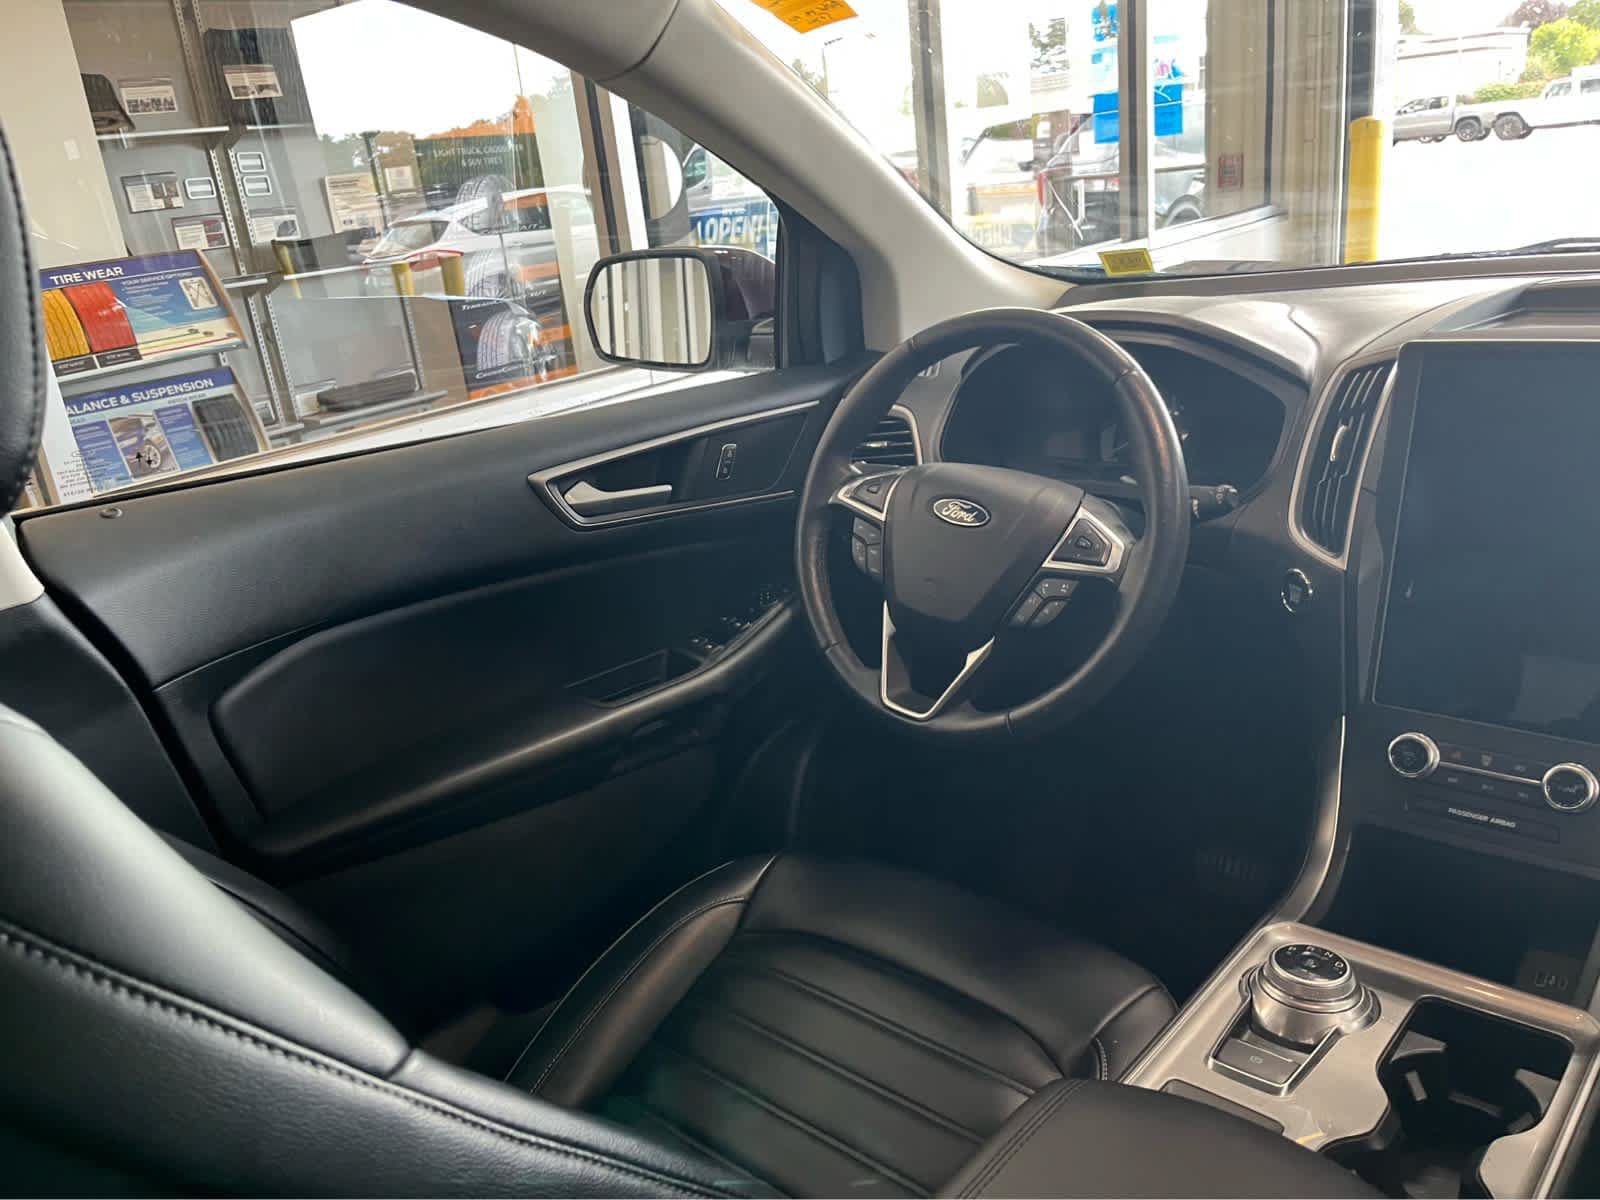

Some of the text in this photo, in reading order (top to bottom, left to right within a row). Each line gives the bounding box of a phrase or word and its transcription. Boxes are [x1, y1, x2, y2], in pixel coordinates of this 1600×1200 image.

[49, 266, 125, 286] TIRE WEAR
[66, 396, 120, 416] ALANCE
[120, 394, 131, 405] &
[131, 378, 215, 403] SUSPENSION
[942, 501, 979, 522] Ford
